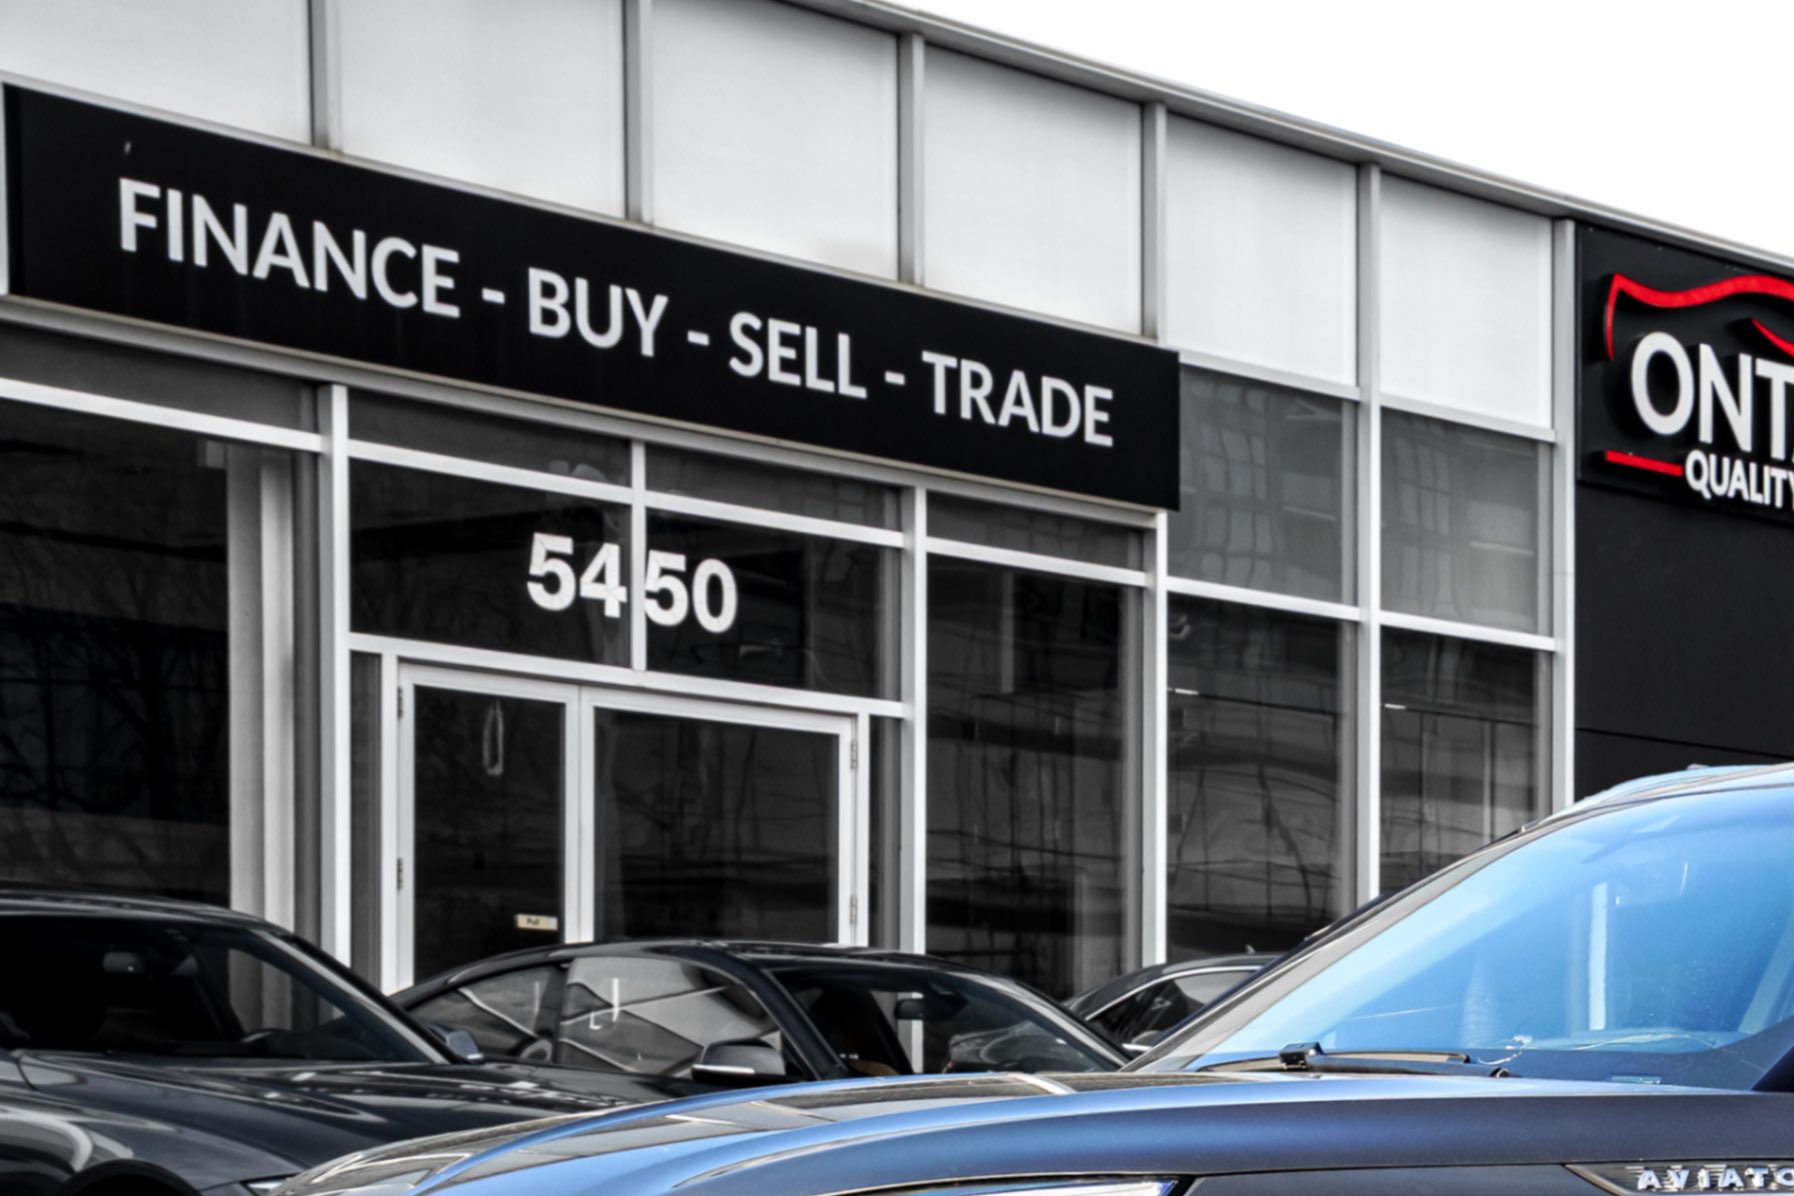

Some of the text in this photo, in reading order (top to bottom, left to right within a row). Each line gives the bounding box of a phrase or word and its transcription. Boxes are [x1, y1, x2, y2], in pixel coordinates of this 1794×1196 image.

[119, 177, 461, 319] FINANCE
[528, 267, 668, 357] BUY
[729, 312, 867, 399] SELL
[922, 351, 1114, 447] TRADE
[526, 532, 738, 634] 5450
